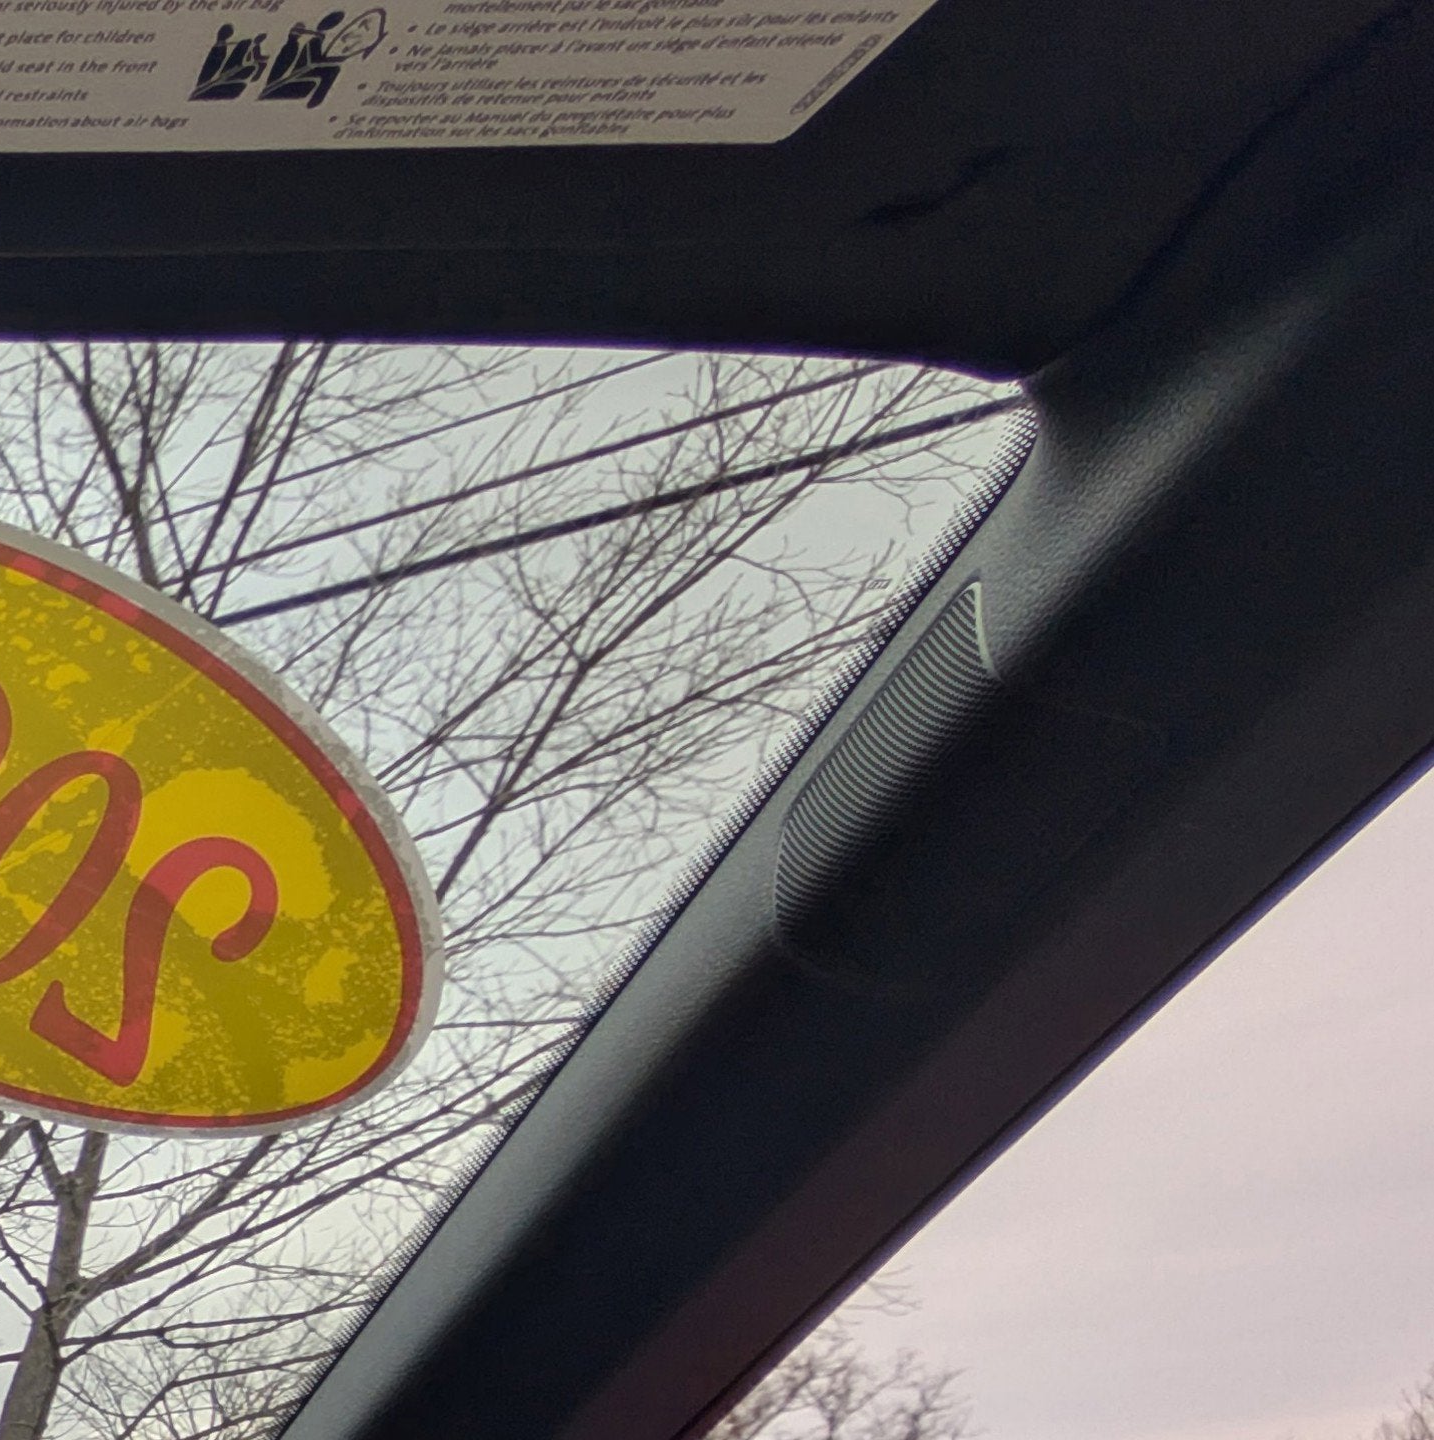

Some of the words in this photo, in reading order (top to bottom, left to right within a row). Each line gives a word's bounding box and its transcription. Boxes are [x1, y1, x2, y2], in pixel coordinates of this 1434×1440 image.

[5, 32, 52, 46] place
[56, 30, 80, 44] for
[83, 29, 155, 43] children
[17, 60, 53, 73] seat
[56, 61, 74, 73] in
[80, 59, 108, 72] the
[112, 59, 157, 73] front
[3, 89, 88, 102] restraints
[71, 115, 121, 127] about
[123, 114, 148, 126] air
[150, 115, 189, 130] bags
